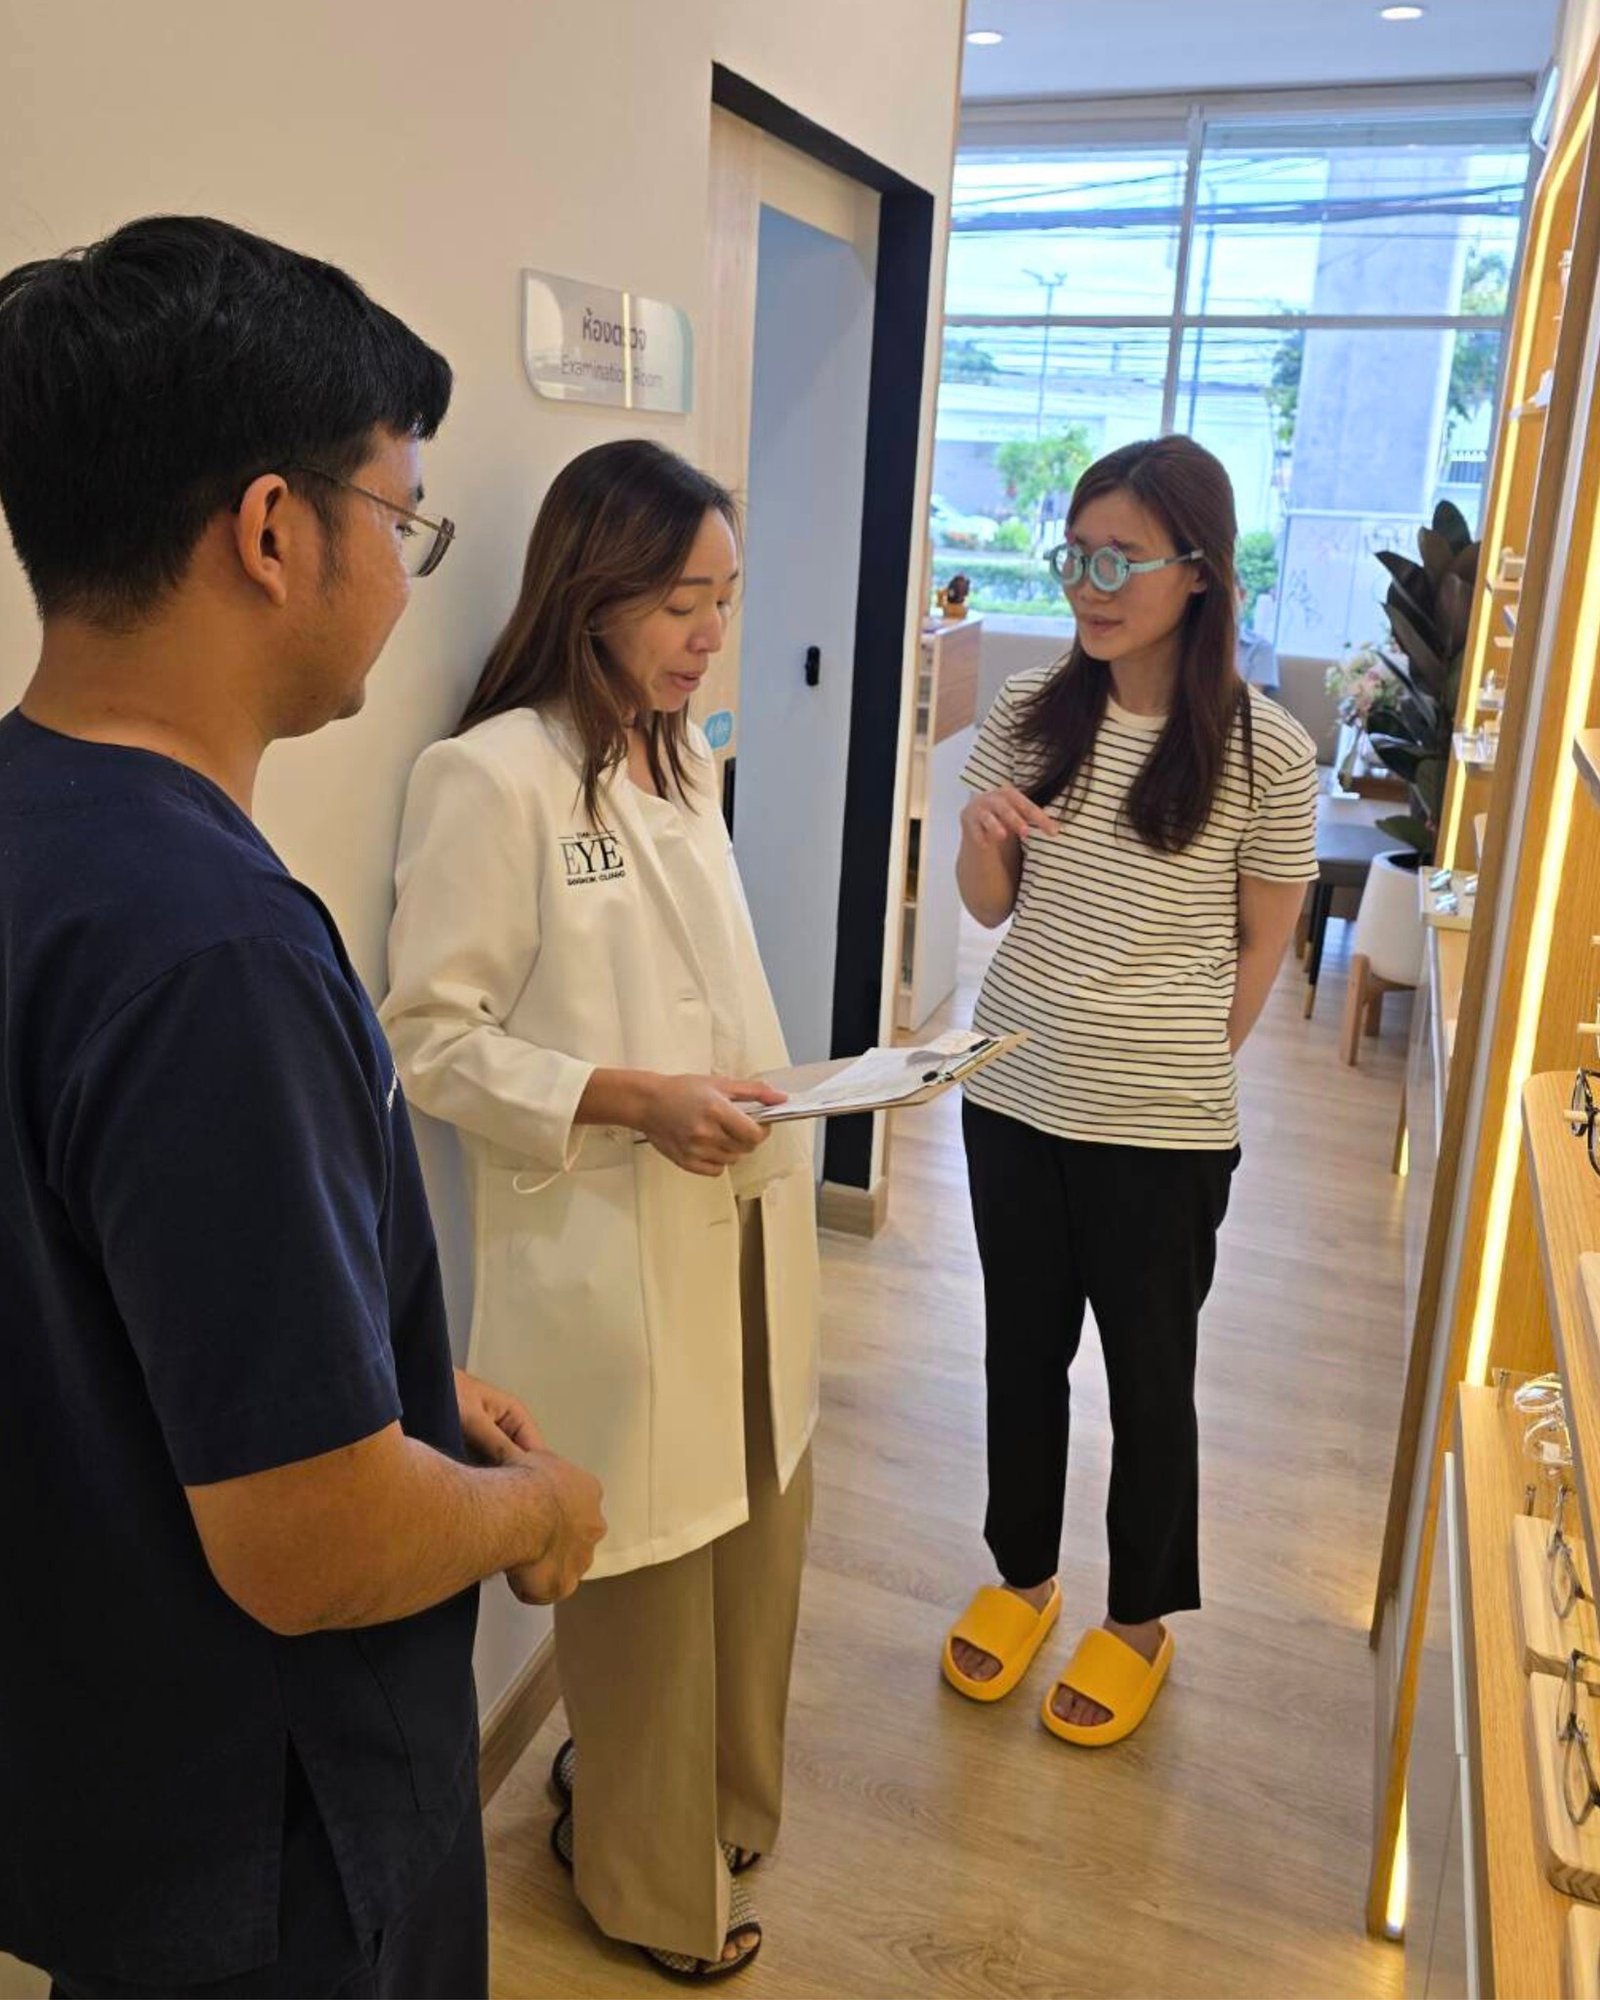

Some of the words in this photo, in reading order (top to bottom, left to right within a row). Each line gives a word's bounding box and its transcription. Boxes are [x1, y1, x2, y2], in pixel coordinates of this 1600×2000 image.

[582, 307, 647, 351] ห้องตวจ
[561, 354, 629, 384] Examinatio
[560, 836, 624, 875] EYE
